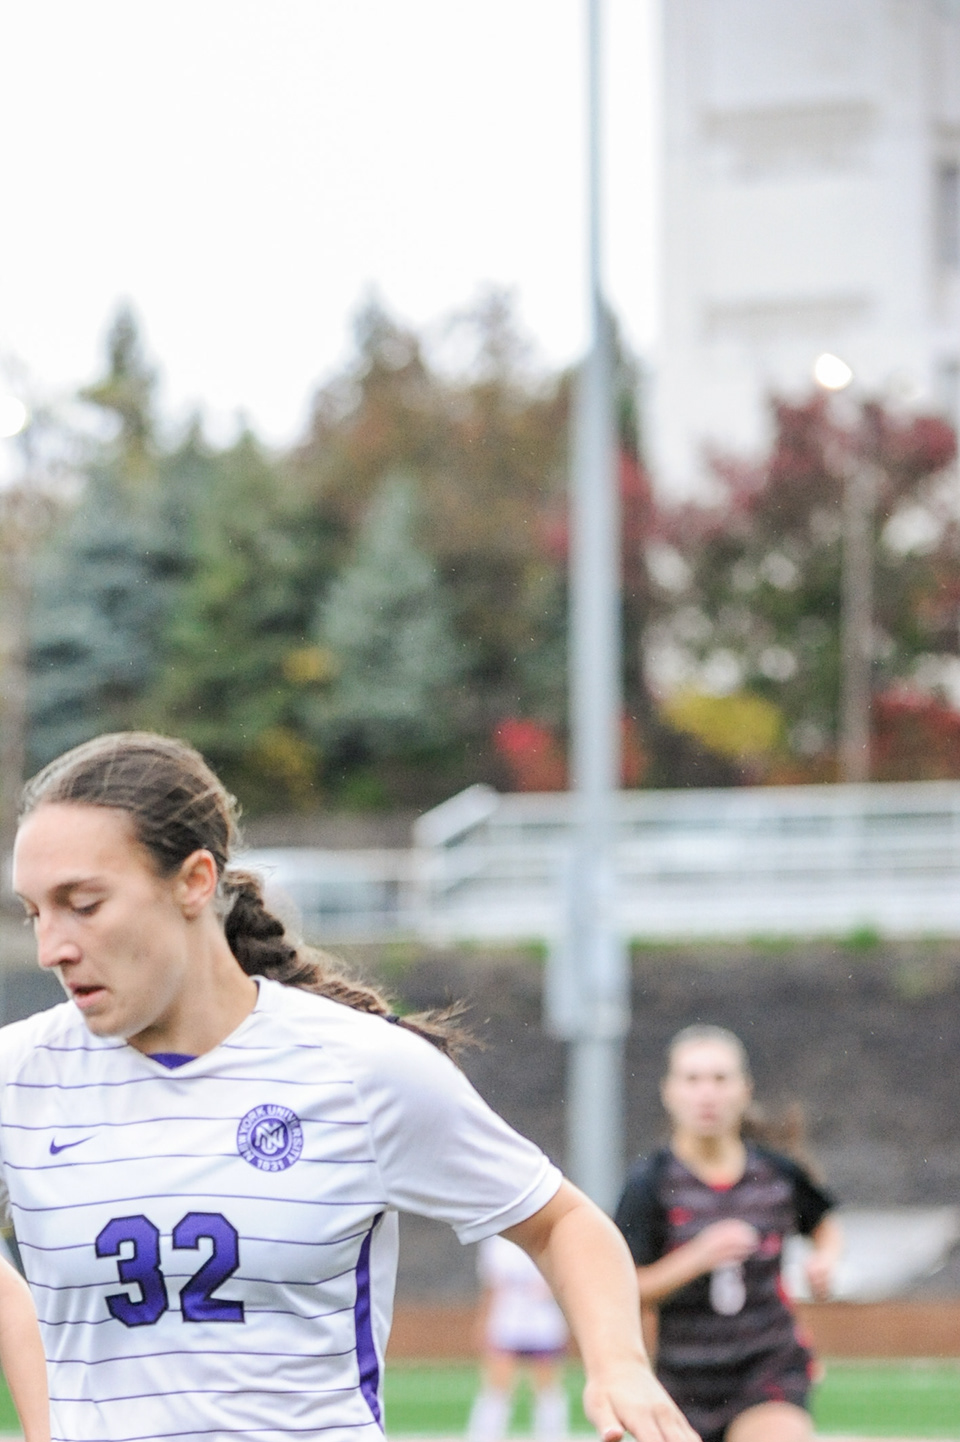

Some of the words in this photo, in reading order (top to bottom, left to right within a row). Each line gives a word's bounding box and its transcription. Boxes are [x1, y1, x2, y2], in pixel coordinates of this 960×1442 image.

[240, 1107, 267, 1134] YORK
[256, 1159, 285, 1171] 1831
[95, 1211, 246, 1328] 32
